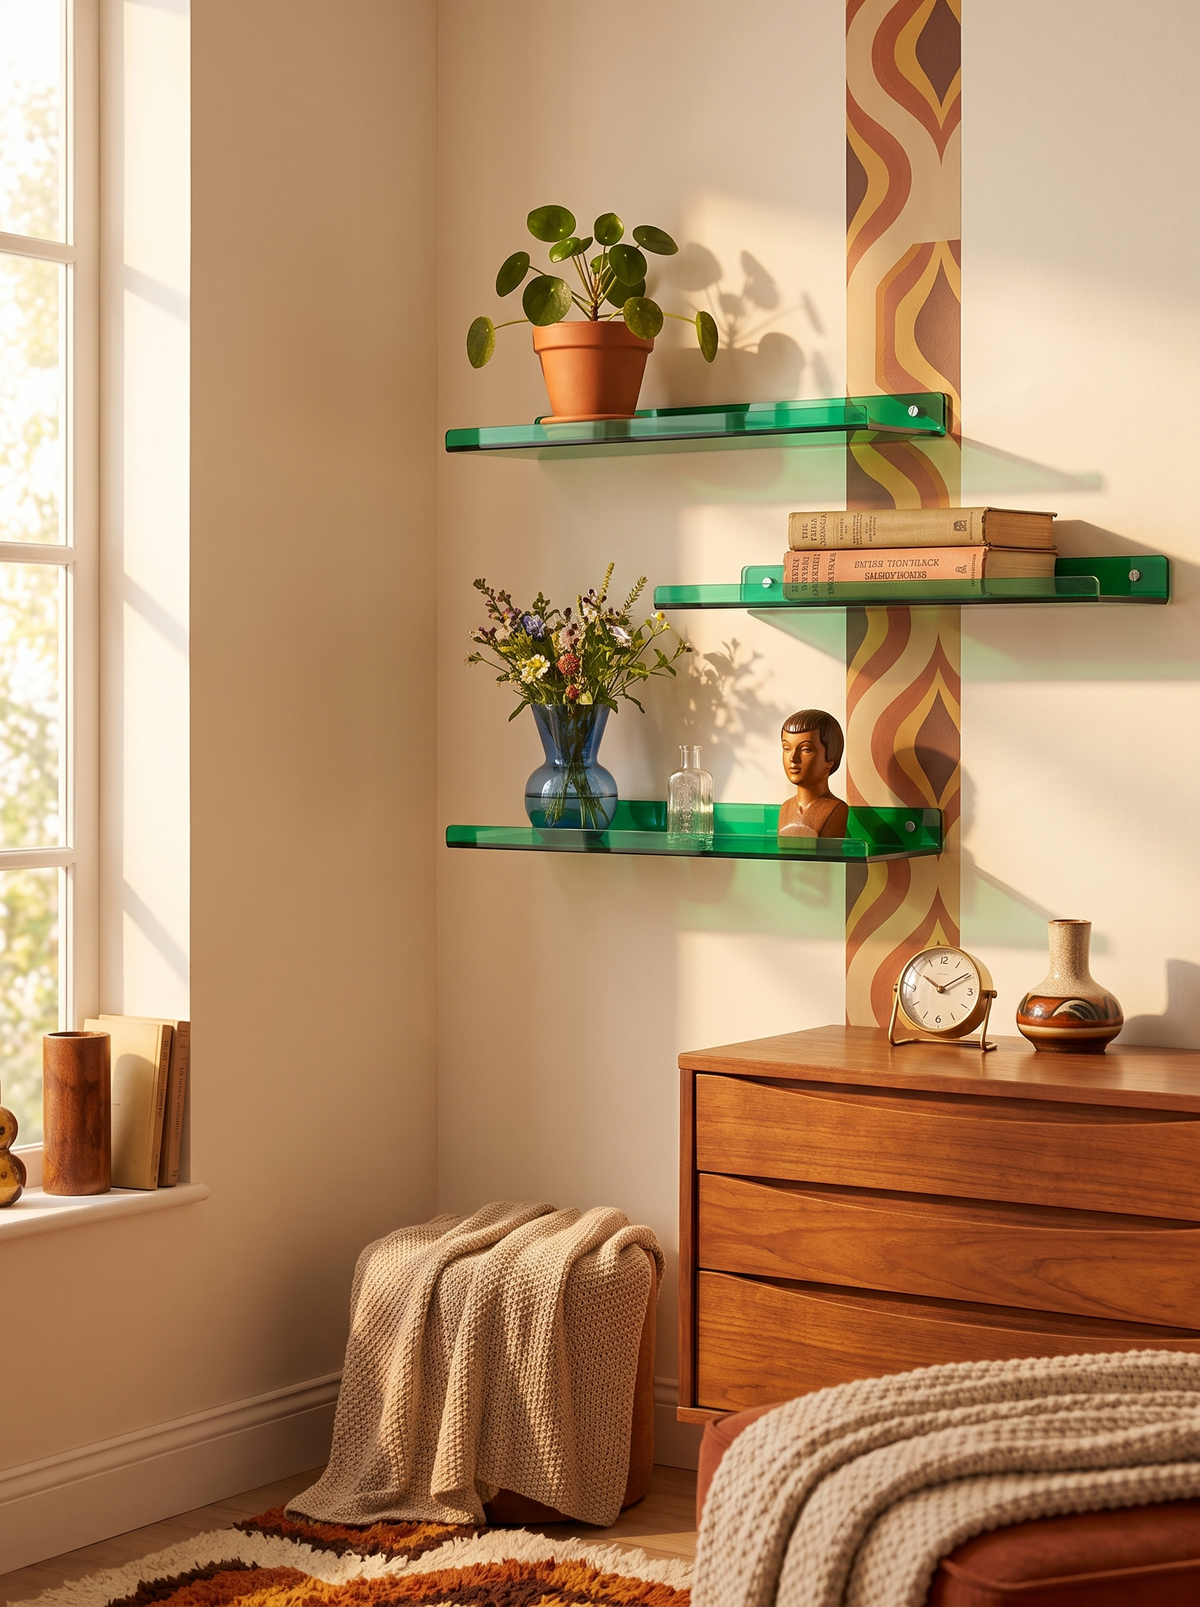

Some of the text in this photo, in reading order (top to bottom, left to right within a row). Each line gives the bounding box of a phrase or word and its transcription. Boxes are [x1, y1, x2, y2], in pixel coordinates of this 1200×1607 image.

[940, 956, 948, 965] 12
[967, 988, 974, 996] 3
[935, 1015, 942, 1023] 6
